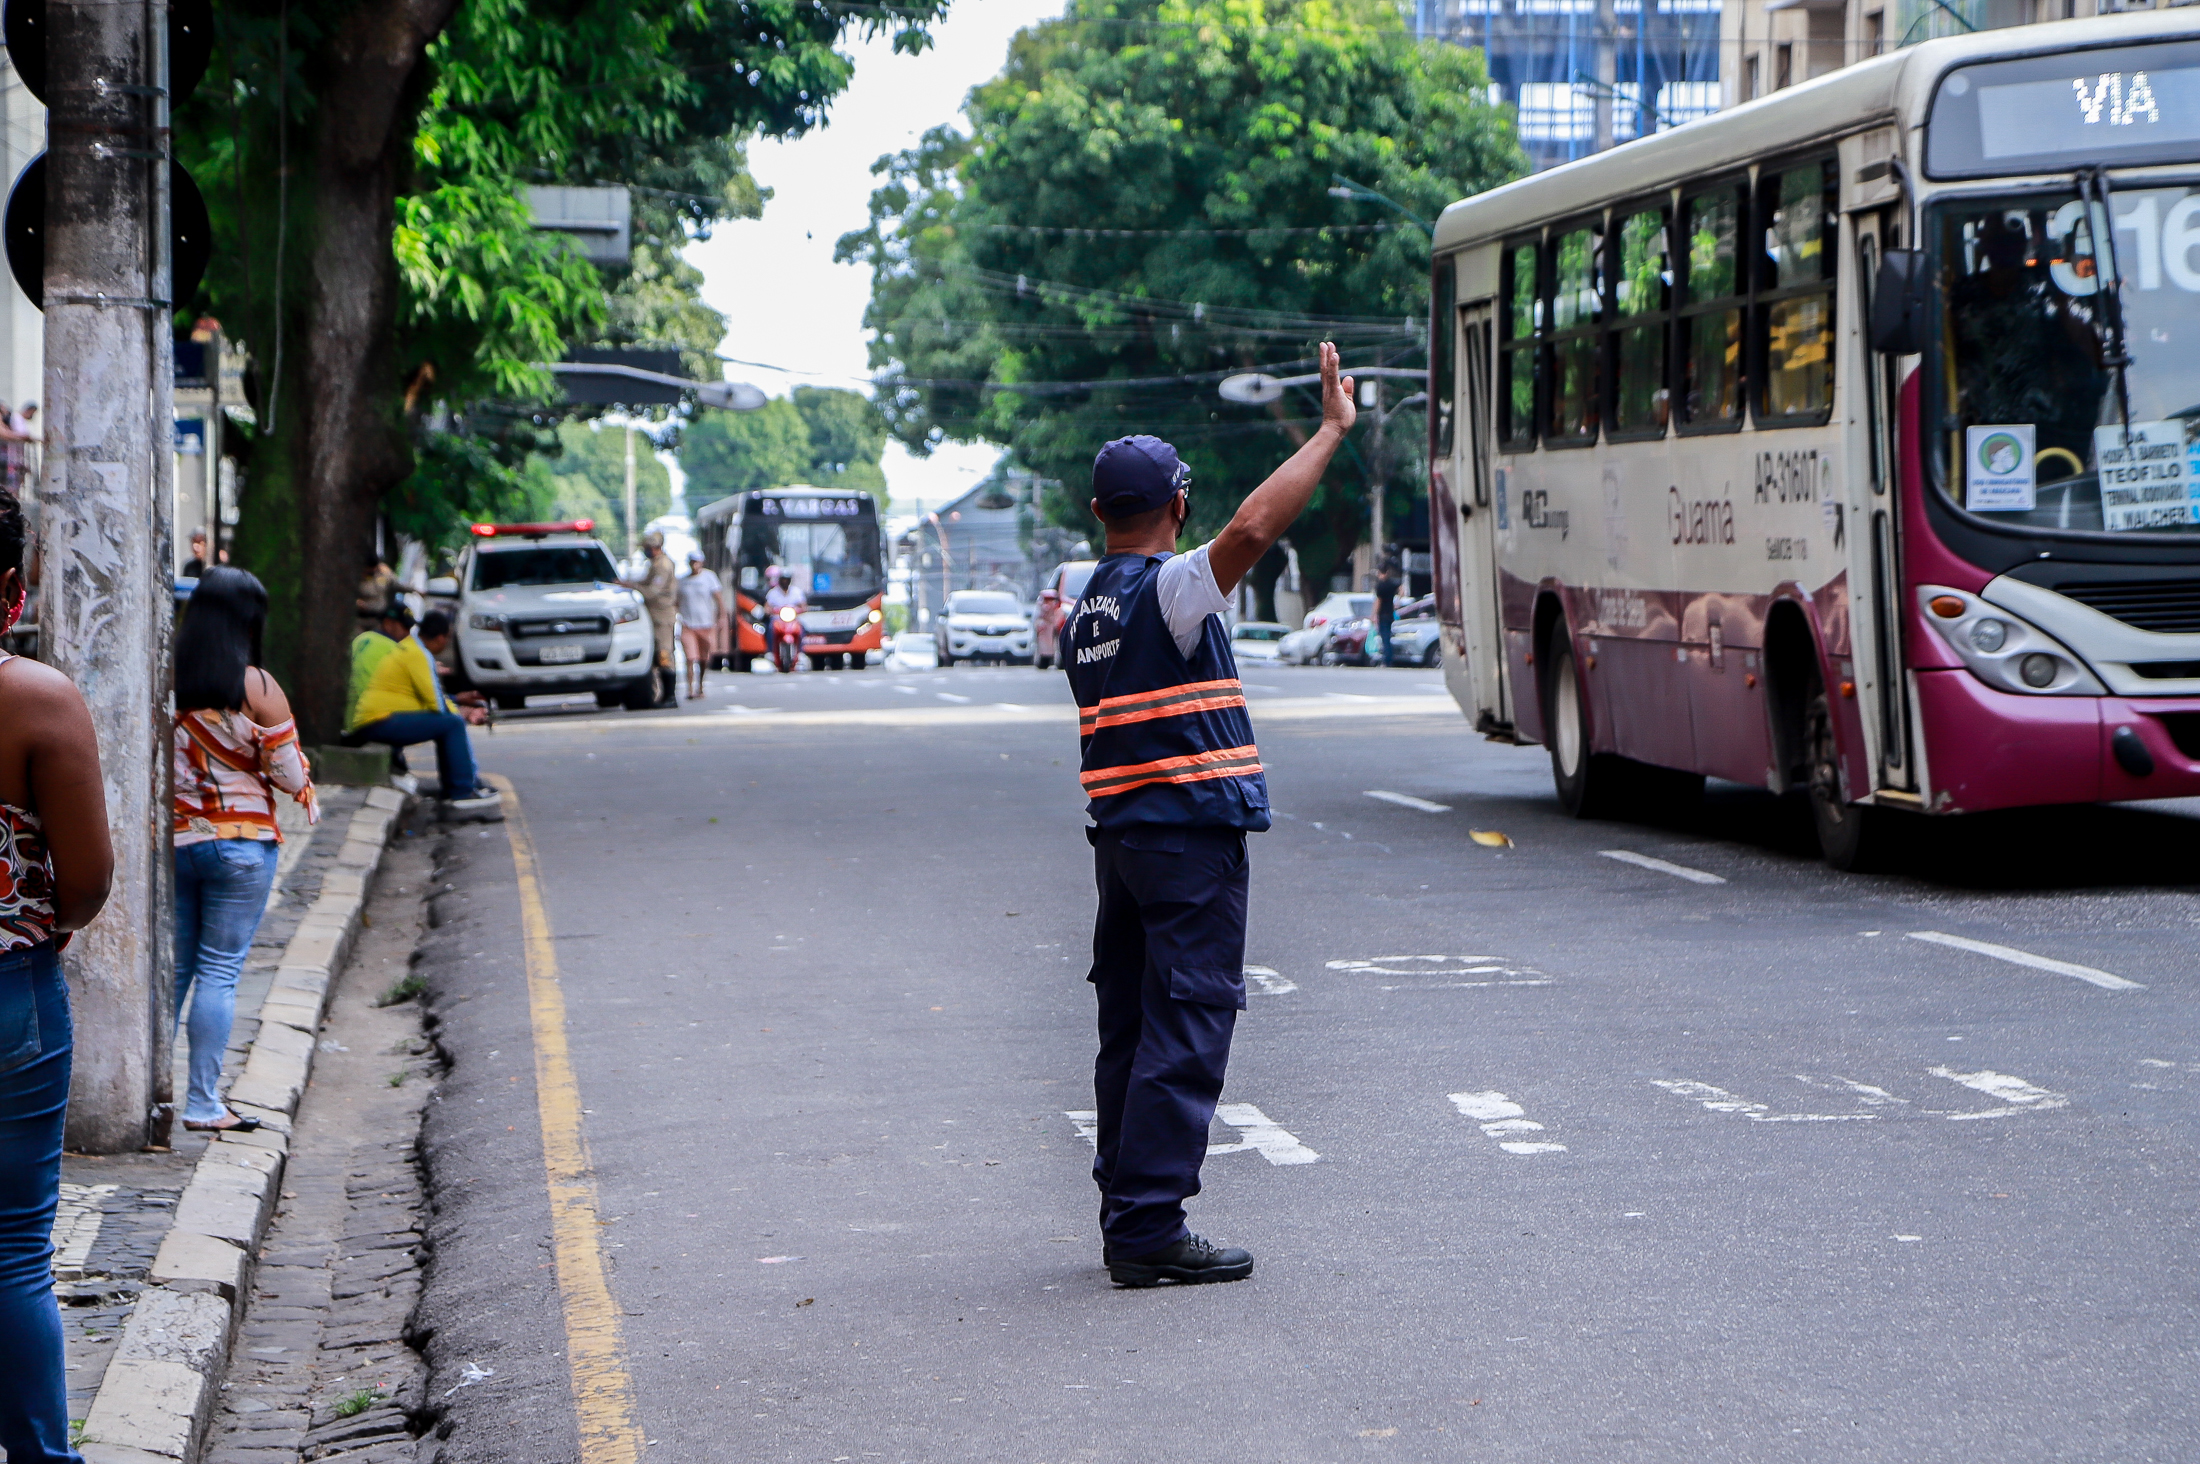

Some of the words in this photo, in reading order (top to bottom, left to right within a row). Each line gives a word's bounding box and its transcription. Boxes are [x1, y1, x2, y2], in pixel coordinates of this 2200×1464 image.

[2072, 71, 2160, 126] VIA
[1754, 448, 1819, 504] AP-31607
[780, 498, 860, 517] VARGAS
[1668, 481, 1735, 545] Guamá
